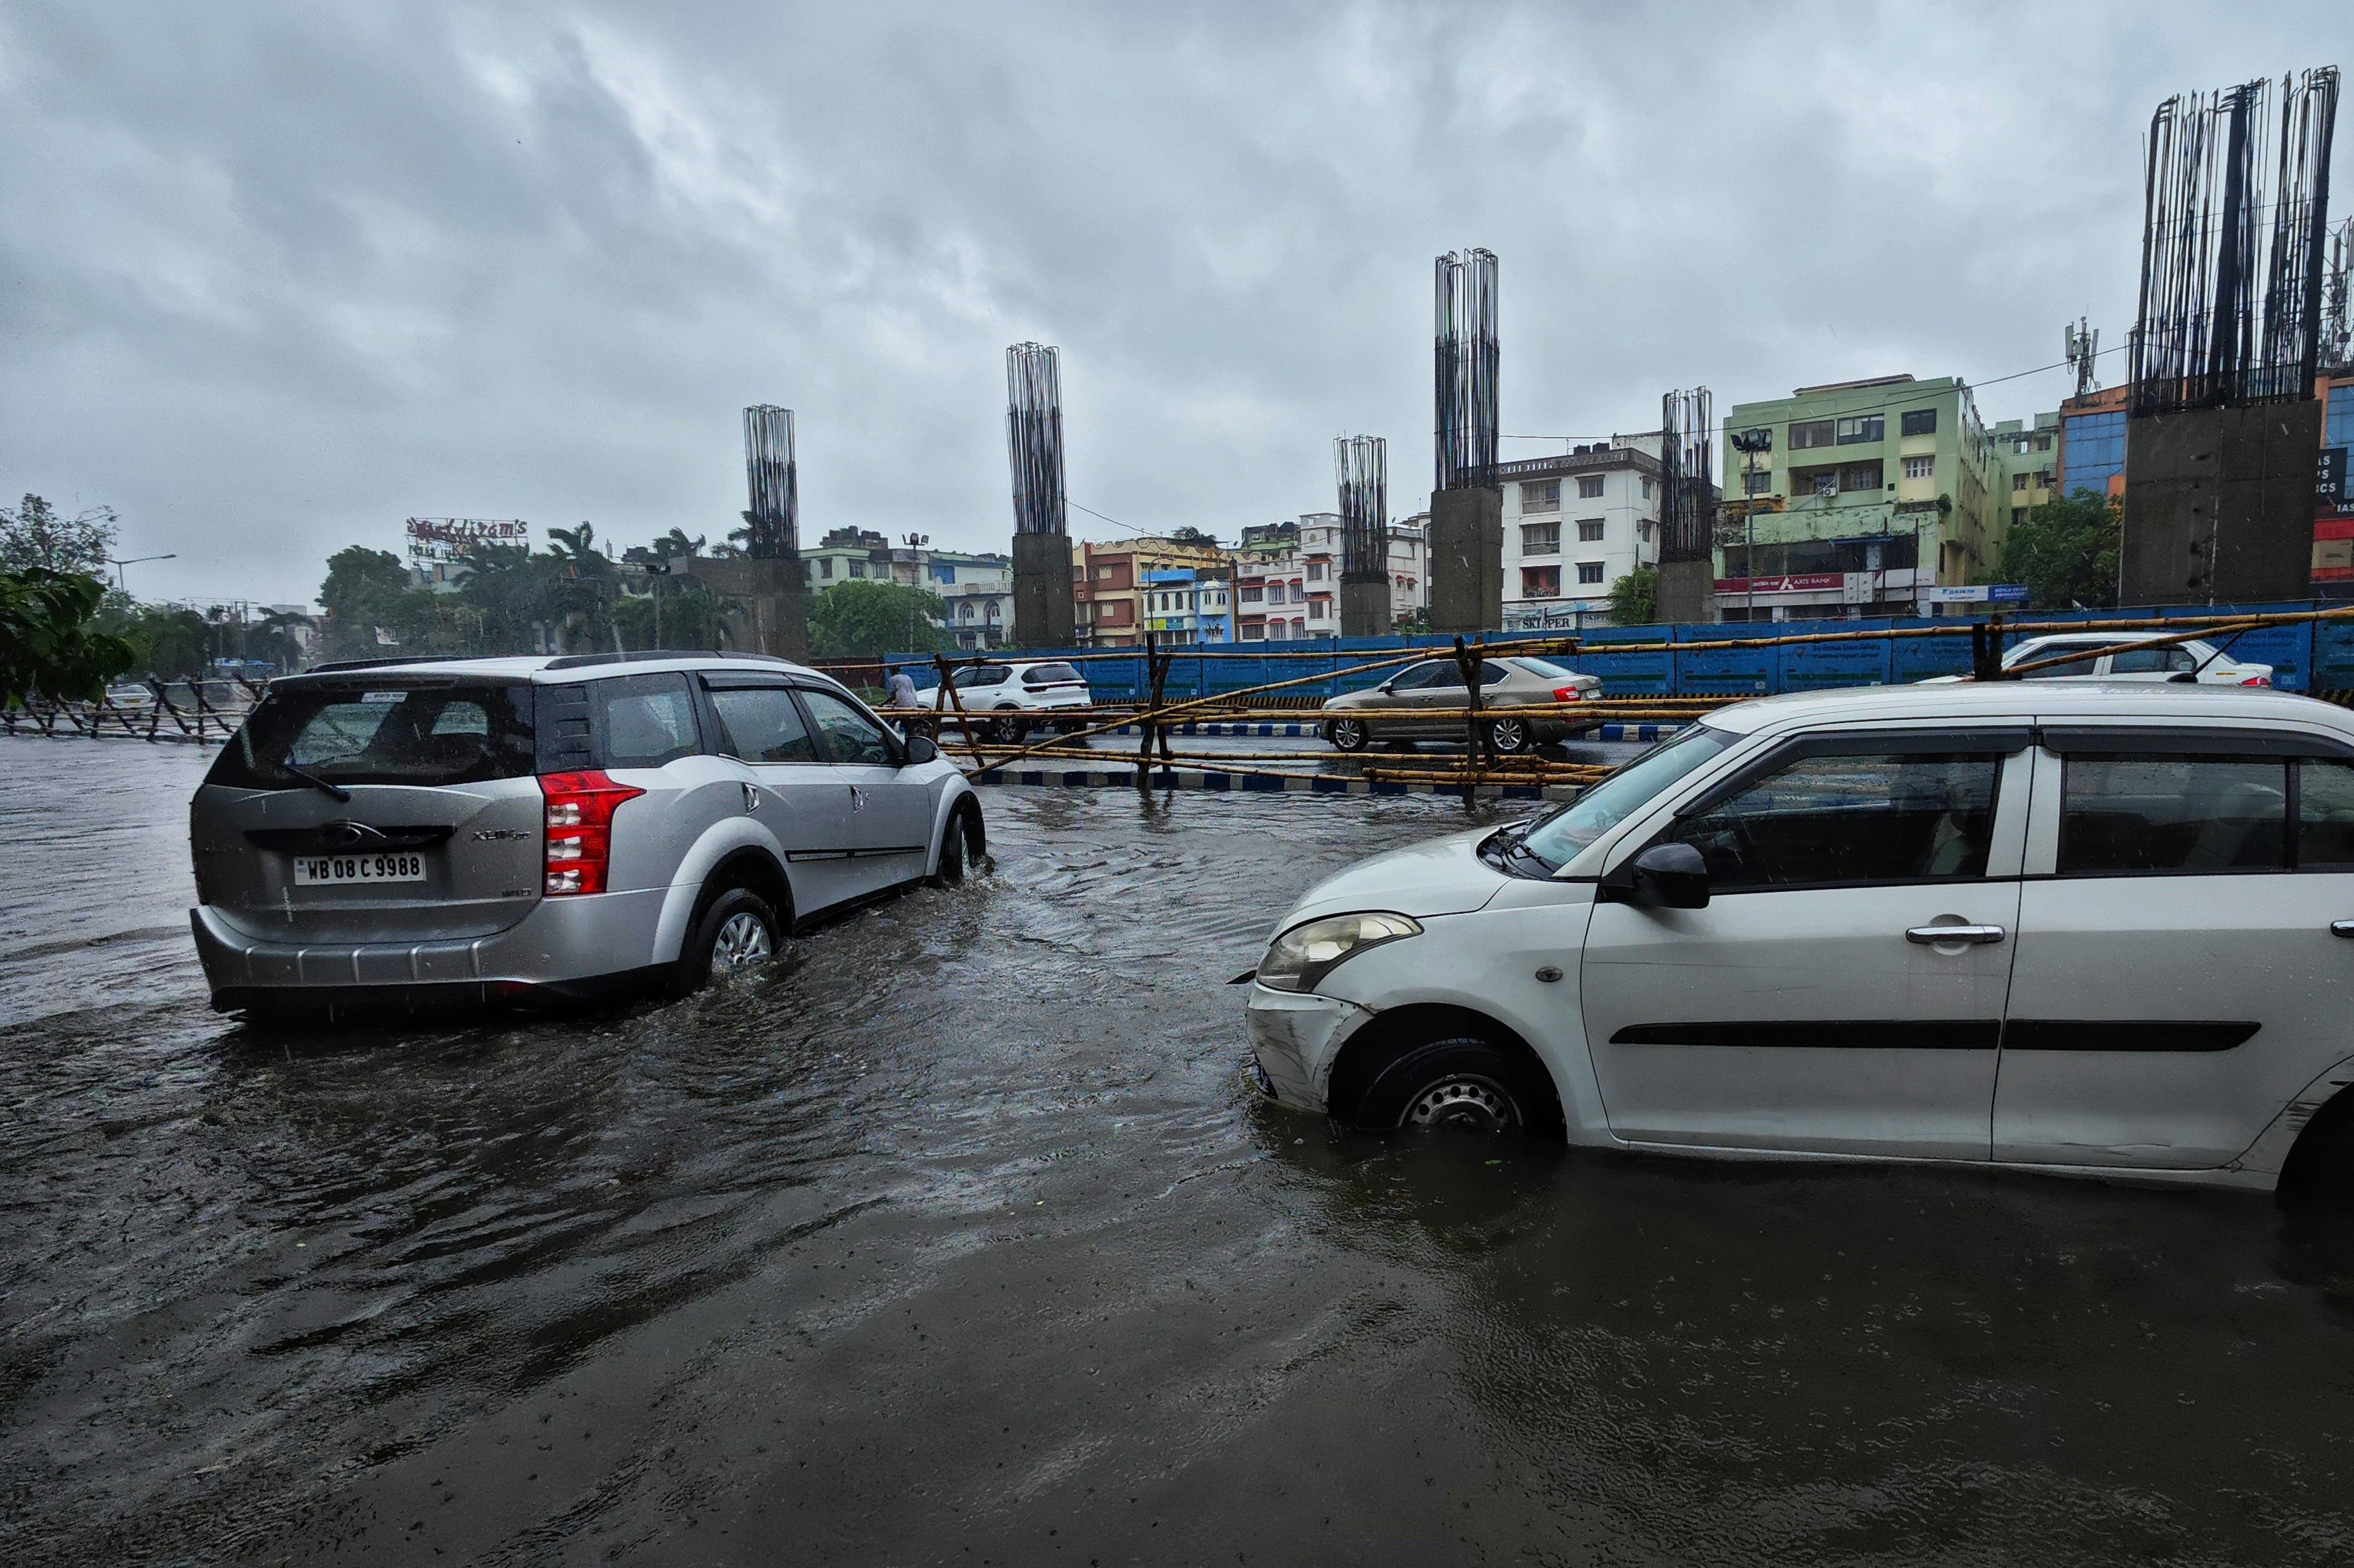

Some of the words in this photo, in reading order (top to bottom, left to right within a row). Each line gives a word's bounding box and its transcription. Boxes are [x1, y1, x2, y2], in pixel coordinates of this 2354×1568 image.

[307, 860, 329, 880] WB
[334, 859, 356, 878] 08
[361, 858, 371, 878] C
[375, 857, 420, 877] 9988
